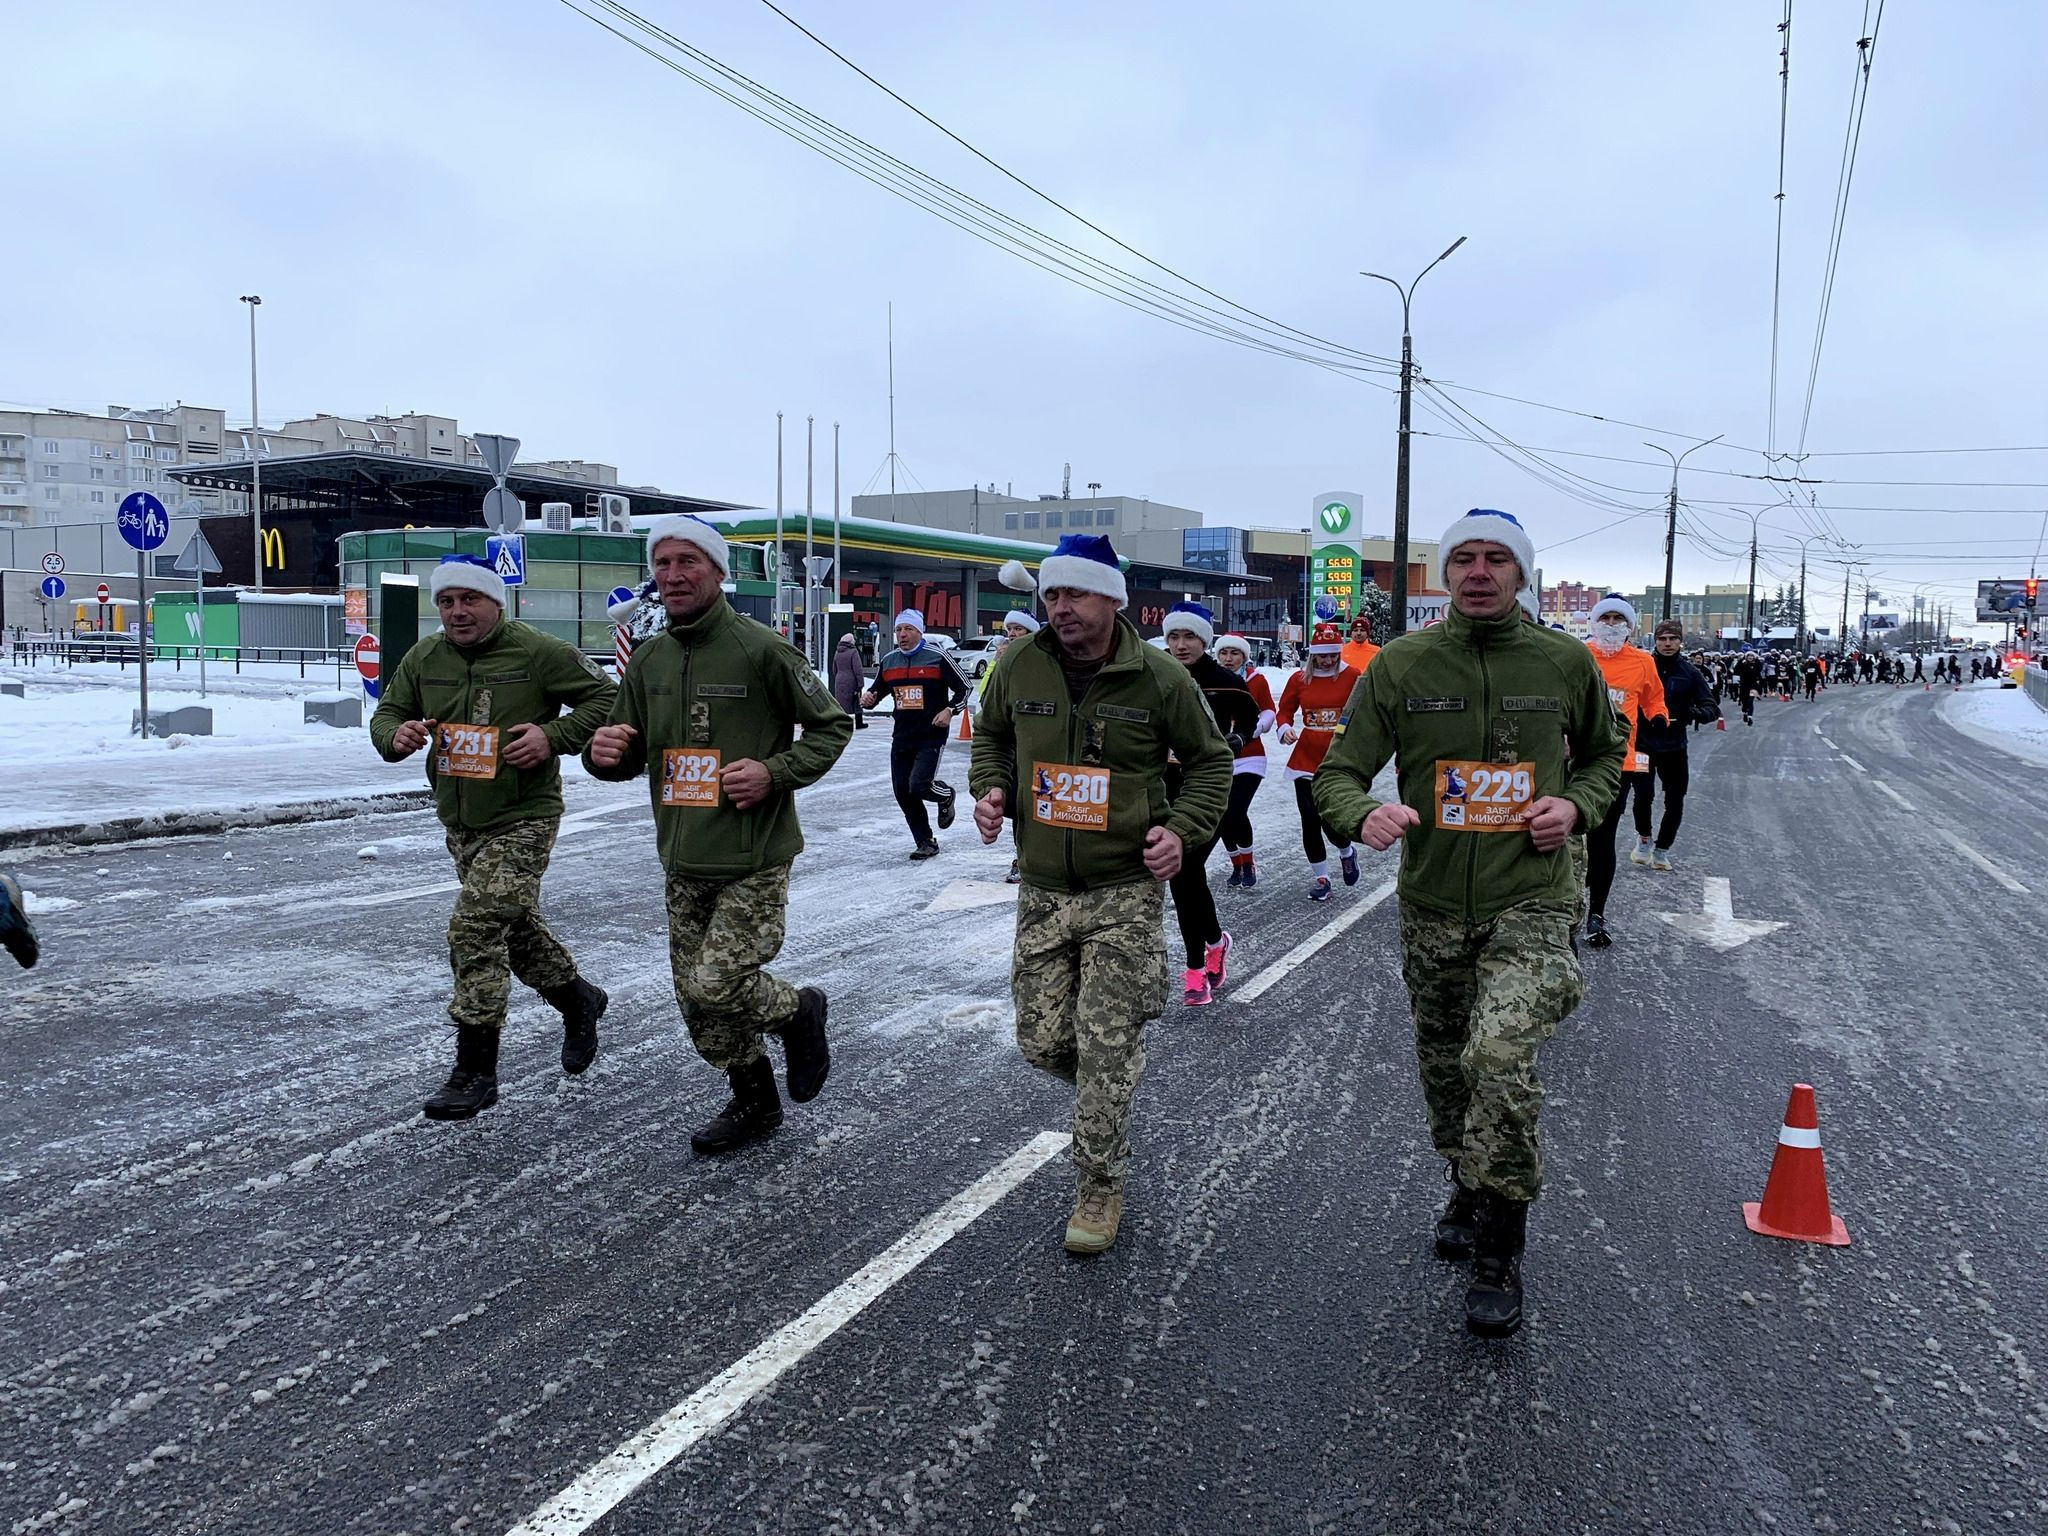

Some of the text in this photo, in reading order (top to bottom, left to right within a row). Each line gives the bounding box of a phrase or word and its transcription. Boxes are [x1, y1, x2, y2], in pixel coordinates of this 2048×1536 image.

[904, 688, 922, 700] 166
[452, 730, 494, 757] 231
[676, 755, 717, 782] 232
[1055, 772, 1108, 805] 230
[1470, 769, 1531, 803] 229
[1053, 811, 1104, 823] МИКОЛАЇВ
[1067, 805, 1090, 814] ЗАБІГ
[1485, 806, 1513, 815] ЗАБІГ
